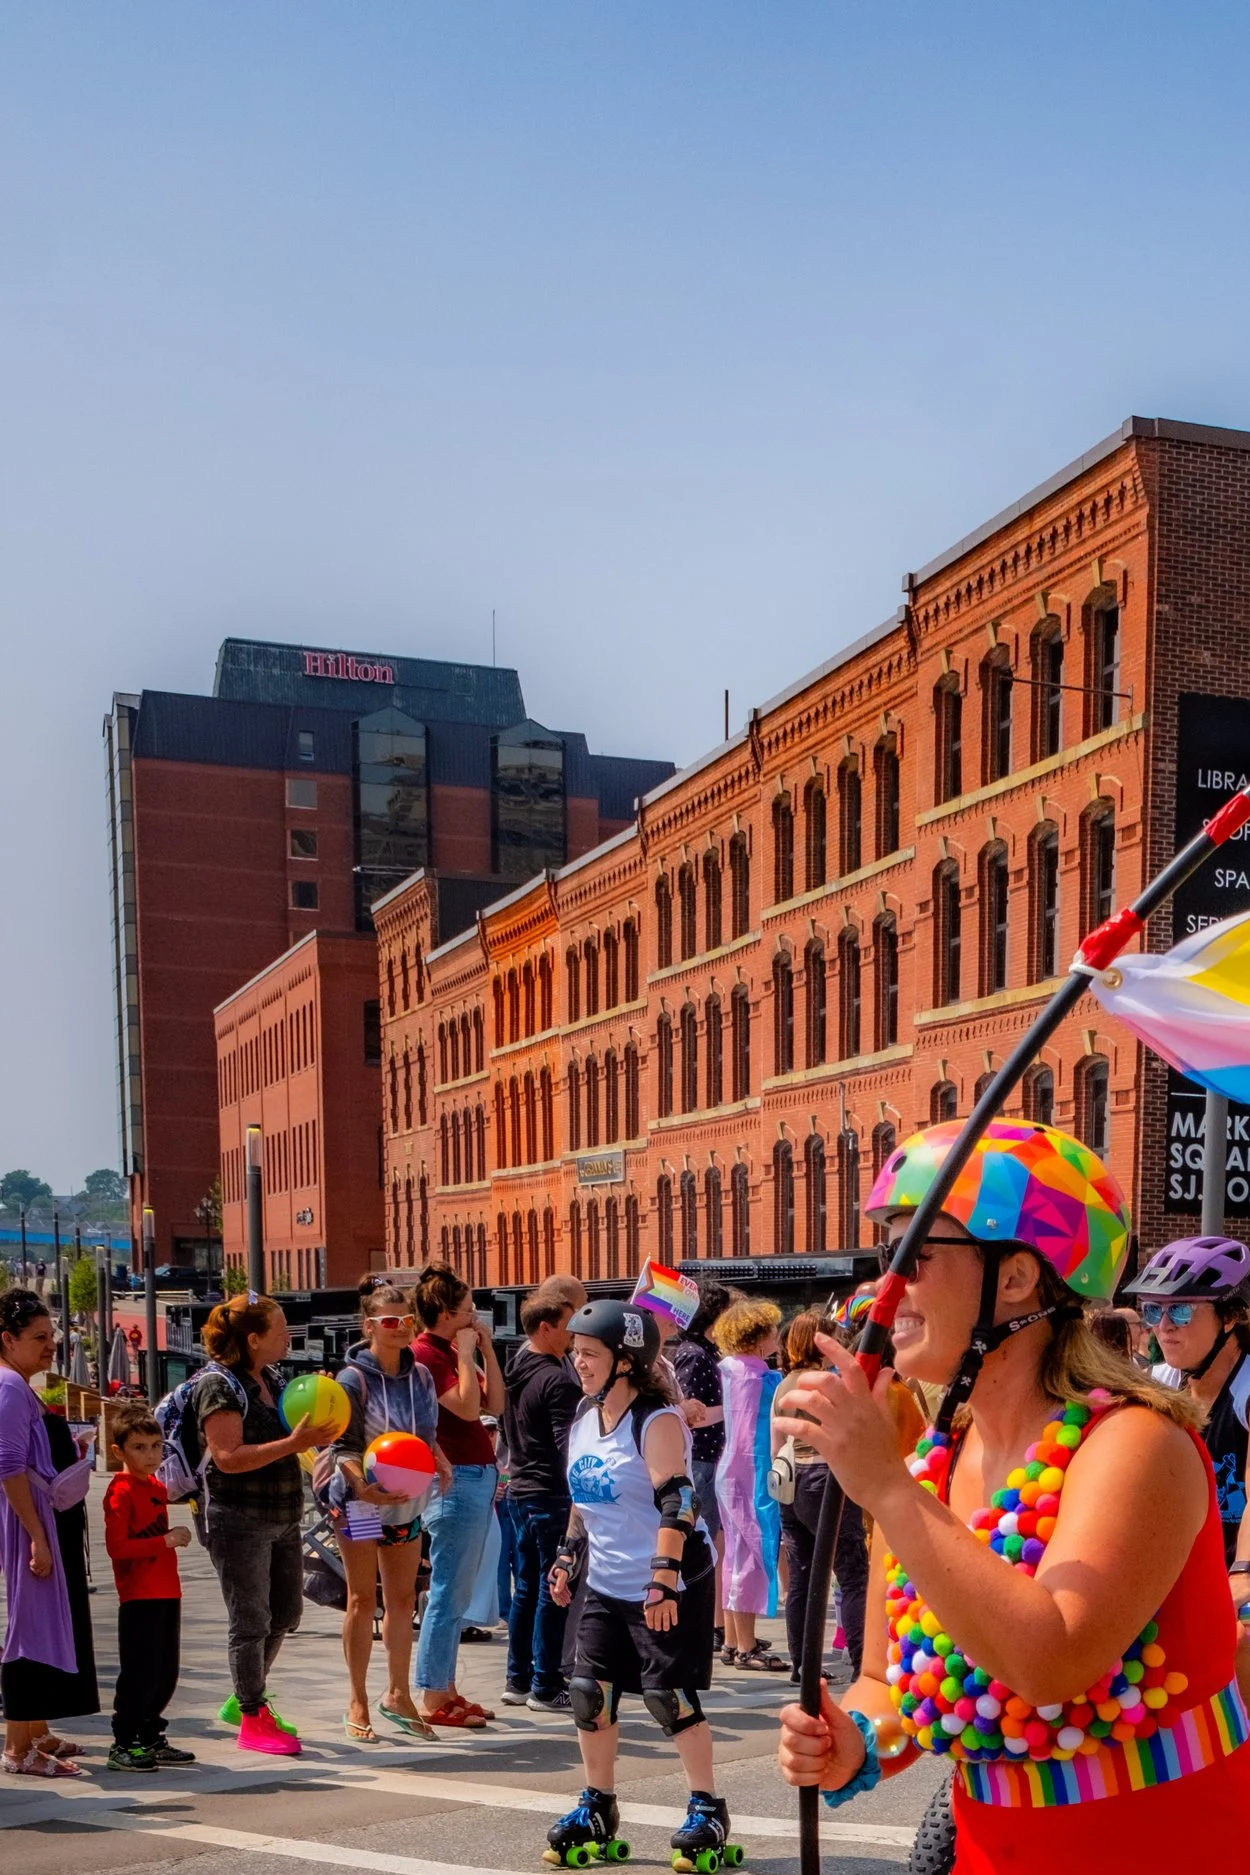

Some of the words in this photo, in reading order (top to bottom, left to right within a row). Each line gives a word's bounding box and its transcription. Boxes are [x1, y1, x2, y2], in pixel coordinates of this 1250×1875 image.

[303, 651, 395, 685] Hilton
[1214, 869, 1250, 890] SPA
[673, 1307, 691, 1321] HERE
